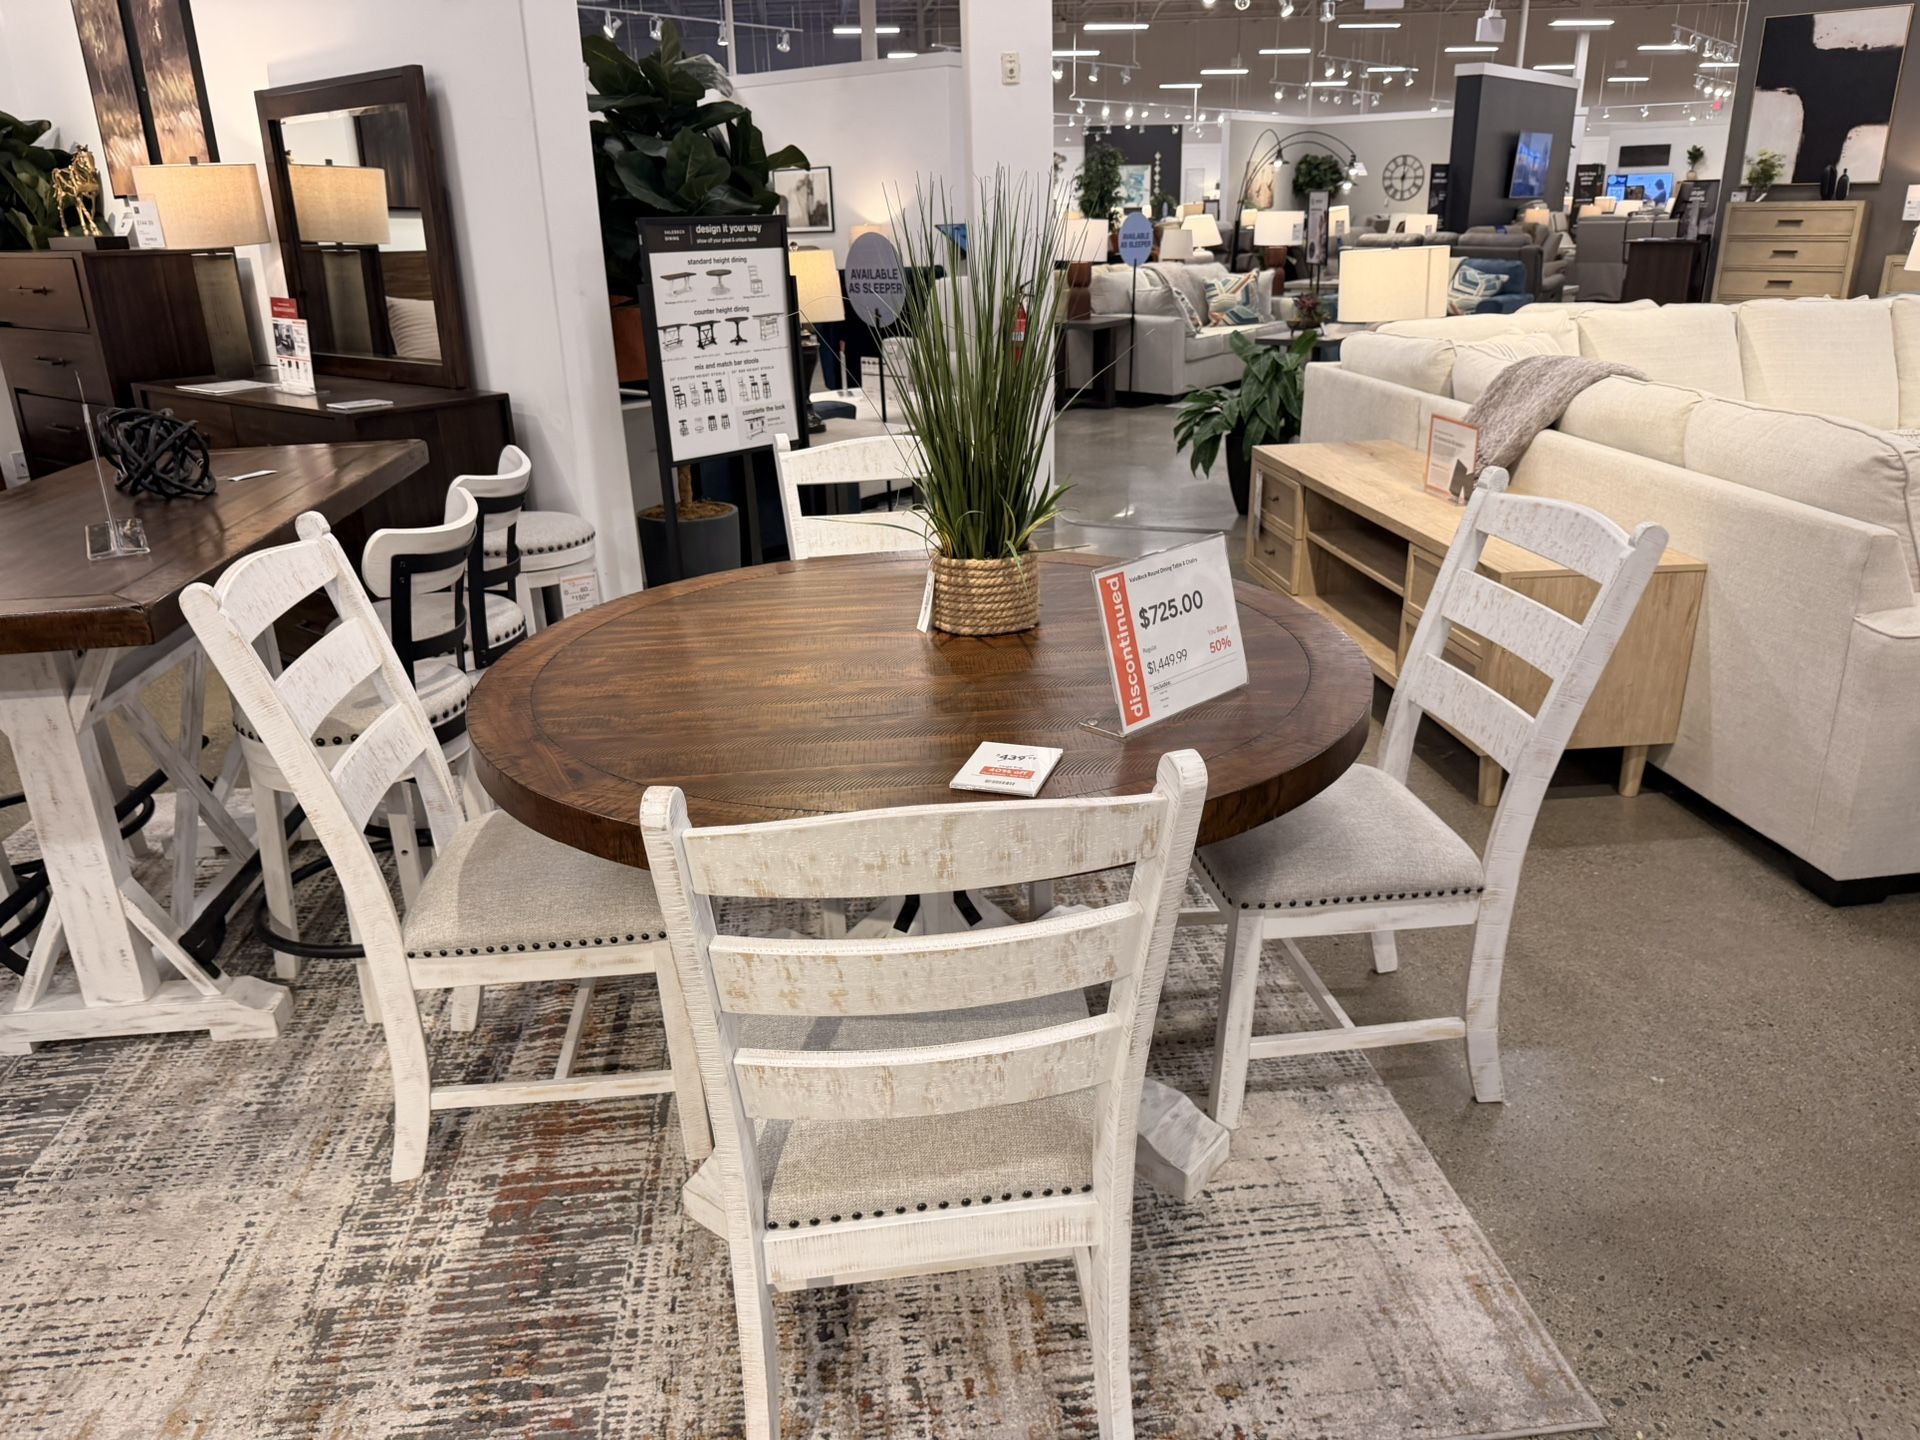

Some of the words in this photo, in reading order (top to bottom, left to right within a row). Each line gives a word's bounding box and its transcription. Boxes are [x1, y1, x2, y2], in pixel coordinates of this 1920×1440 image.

[696, 224, 721, 235] design
[722, 224, 728, 233] it
[729, 225, 746, 234] your
[747, 224, 762, 234] way
[688, 257, 712, 266] standard
[713, 256, 730, 265] height
[731, 256, 748, 264] dining
[850, 268, 898, 280] AVAILABLE
[849, 283, 860, 294] AS
[862, 282, 902, 294] SLEEPER
[694, 308, 714, 316] counter
[716, 306, 732, 314] height
[716, 360, 732, 368] match
[742, 408, 765, 416] complete
[1139, 590, 1203, 630] $725.00
[1216, 624, 1228, 632] Save
[1106, 576, 1145, 718] discontinued
[1210, 636, 1232, 654] 50%
[1147, 648, 1188, 675] $1,449.99
